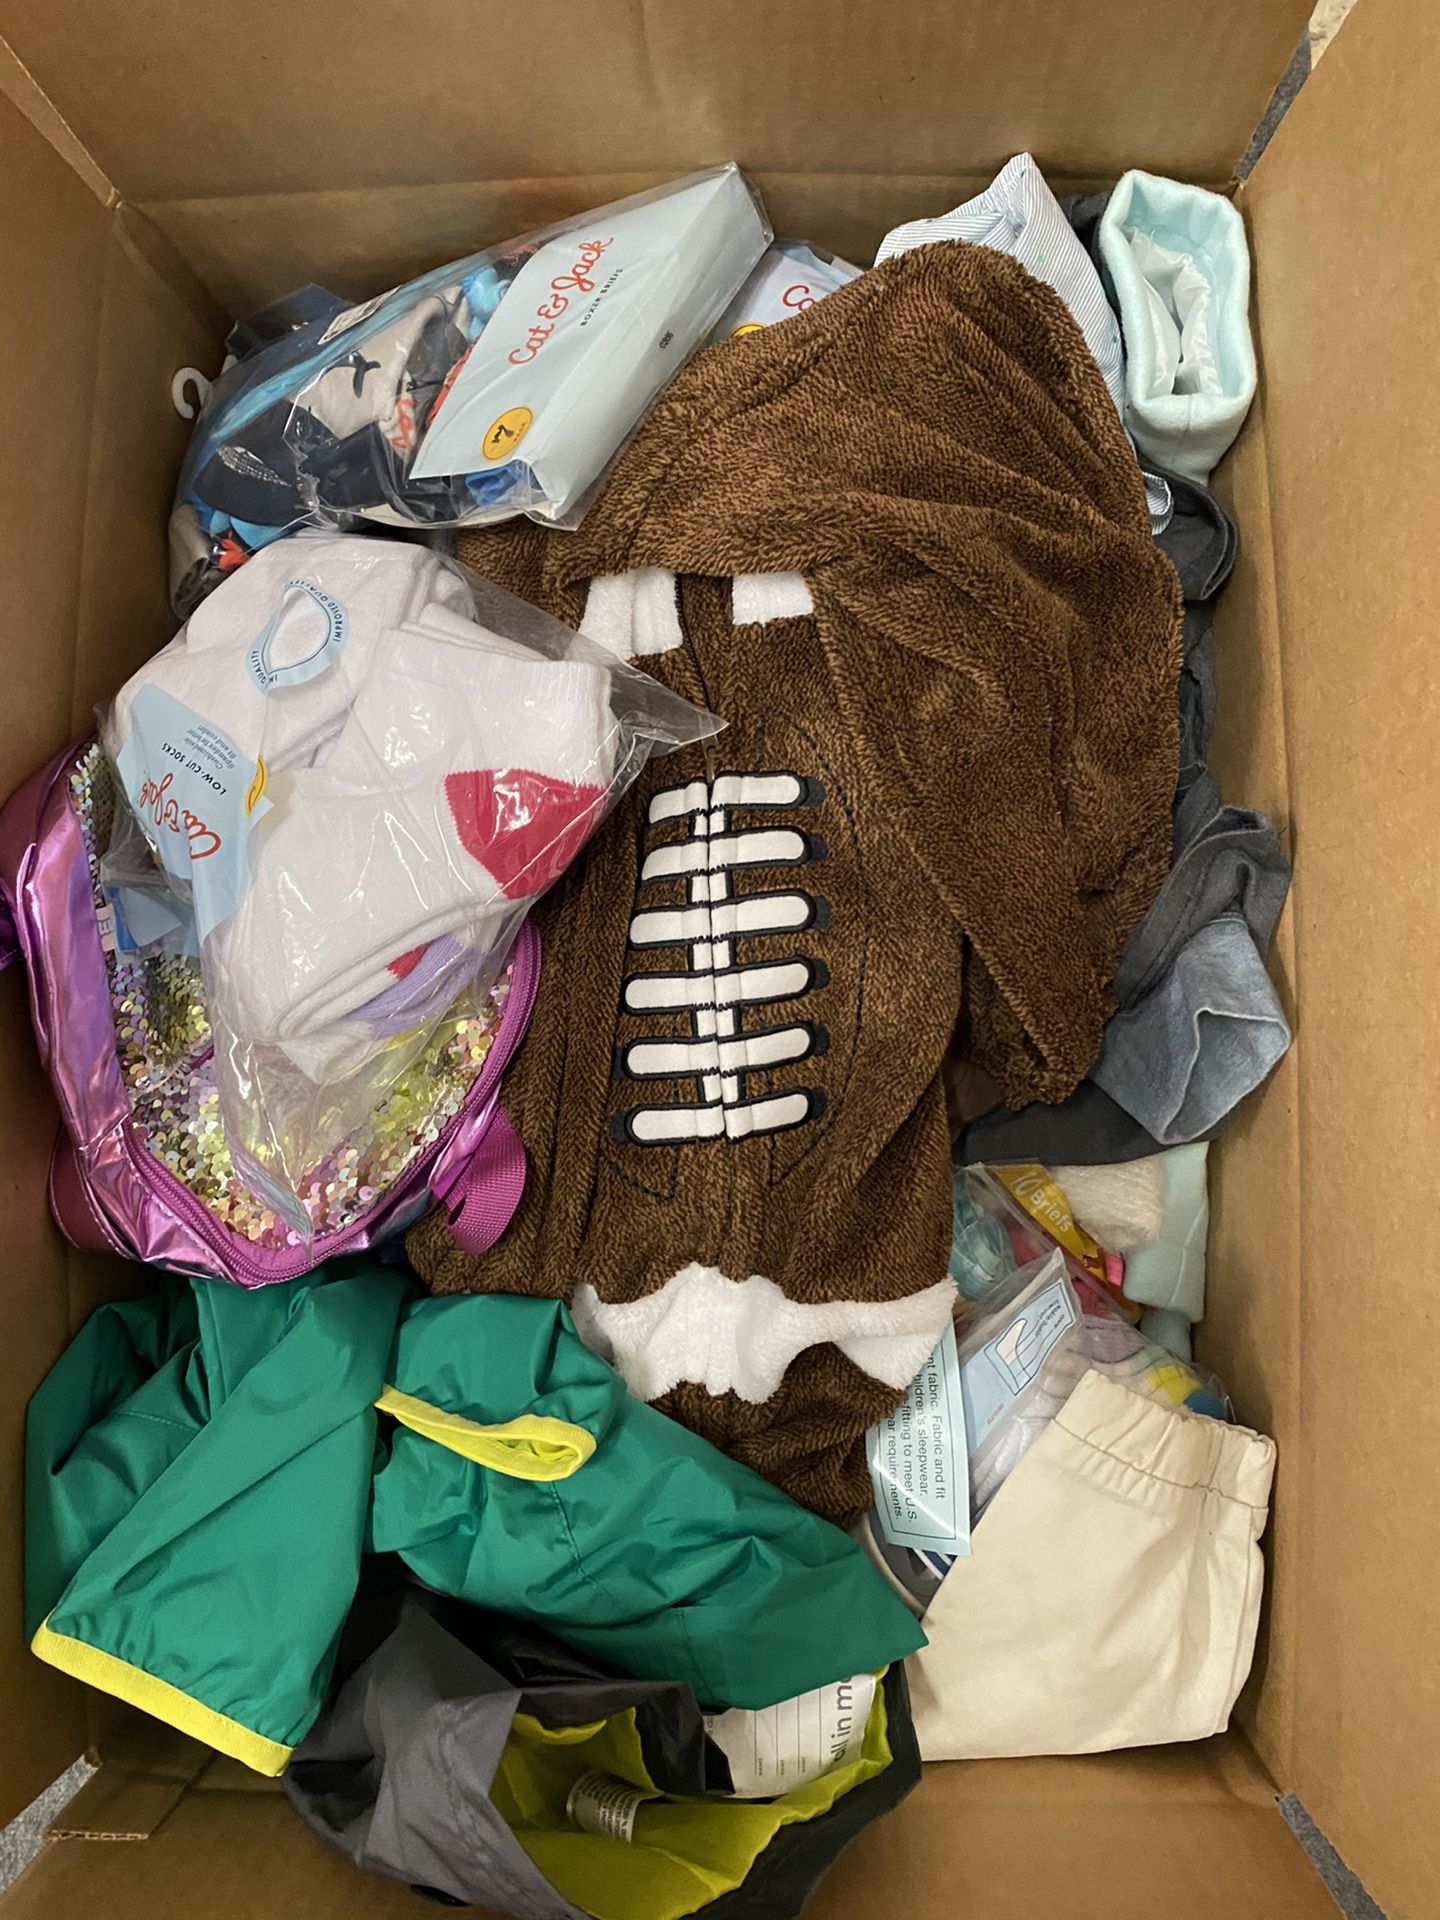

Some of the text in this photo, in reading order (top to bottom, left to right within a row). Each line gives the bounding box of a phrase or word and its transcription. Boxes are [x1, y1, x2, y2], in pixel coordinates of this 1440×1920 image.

[508, 237, 615, 365] Cat & Jack
[580, 268, 623, 326] BOXER BRIEFS
[491, 424, 515, 444] 7
[327, 602, 344, 643] IMPROVED
[215, 738, 230, 751] and
[161, 742, 227, 796] LOW-CUT SOCKS
[1011, 1172, 1073, 1233] 10 Briefs
[914, 1373, 927, 1426] hildren's
[900, 1400, 913, 1440] -fitting
[932, 1415, 945, 1456] Fabric
[903, 1444, 913, 1457] to
[904, 1460, 914, 1493] meet
[934, 1459, 946, 1483] and
[936, 1487, 947, 1500] fit
[830, 1717, 852, 1739] in
[830, 1739, 849, 1762] all
